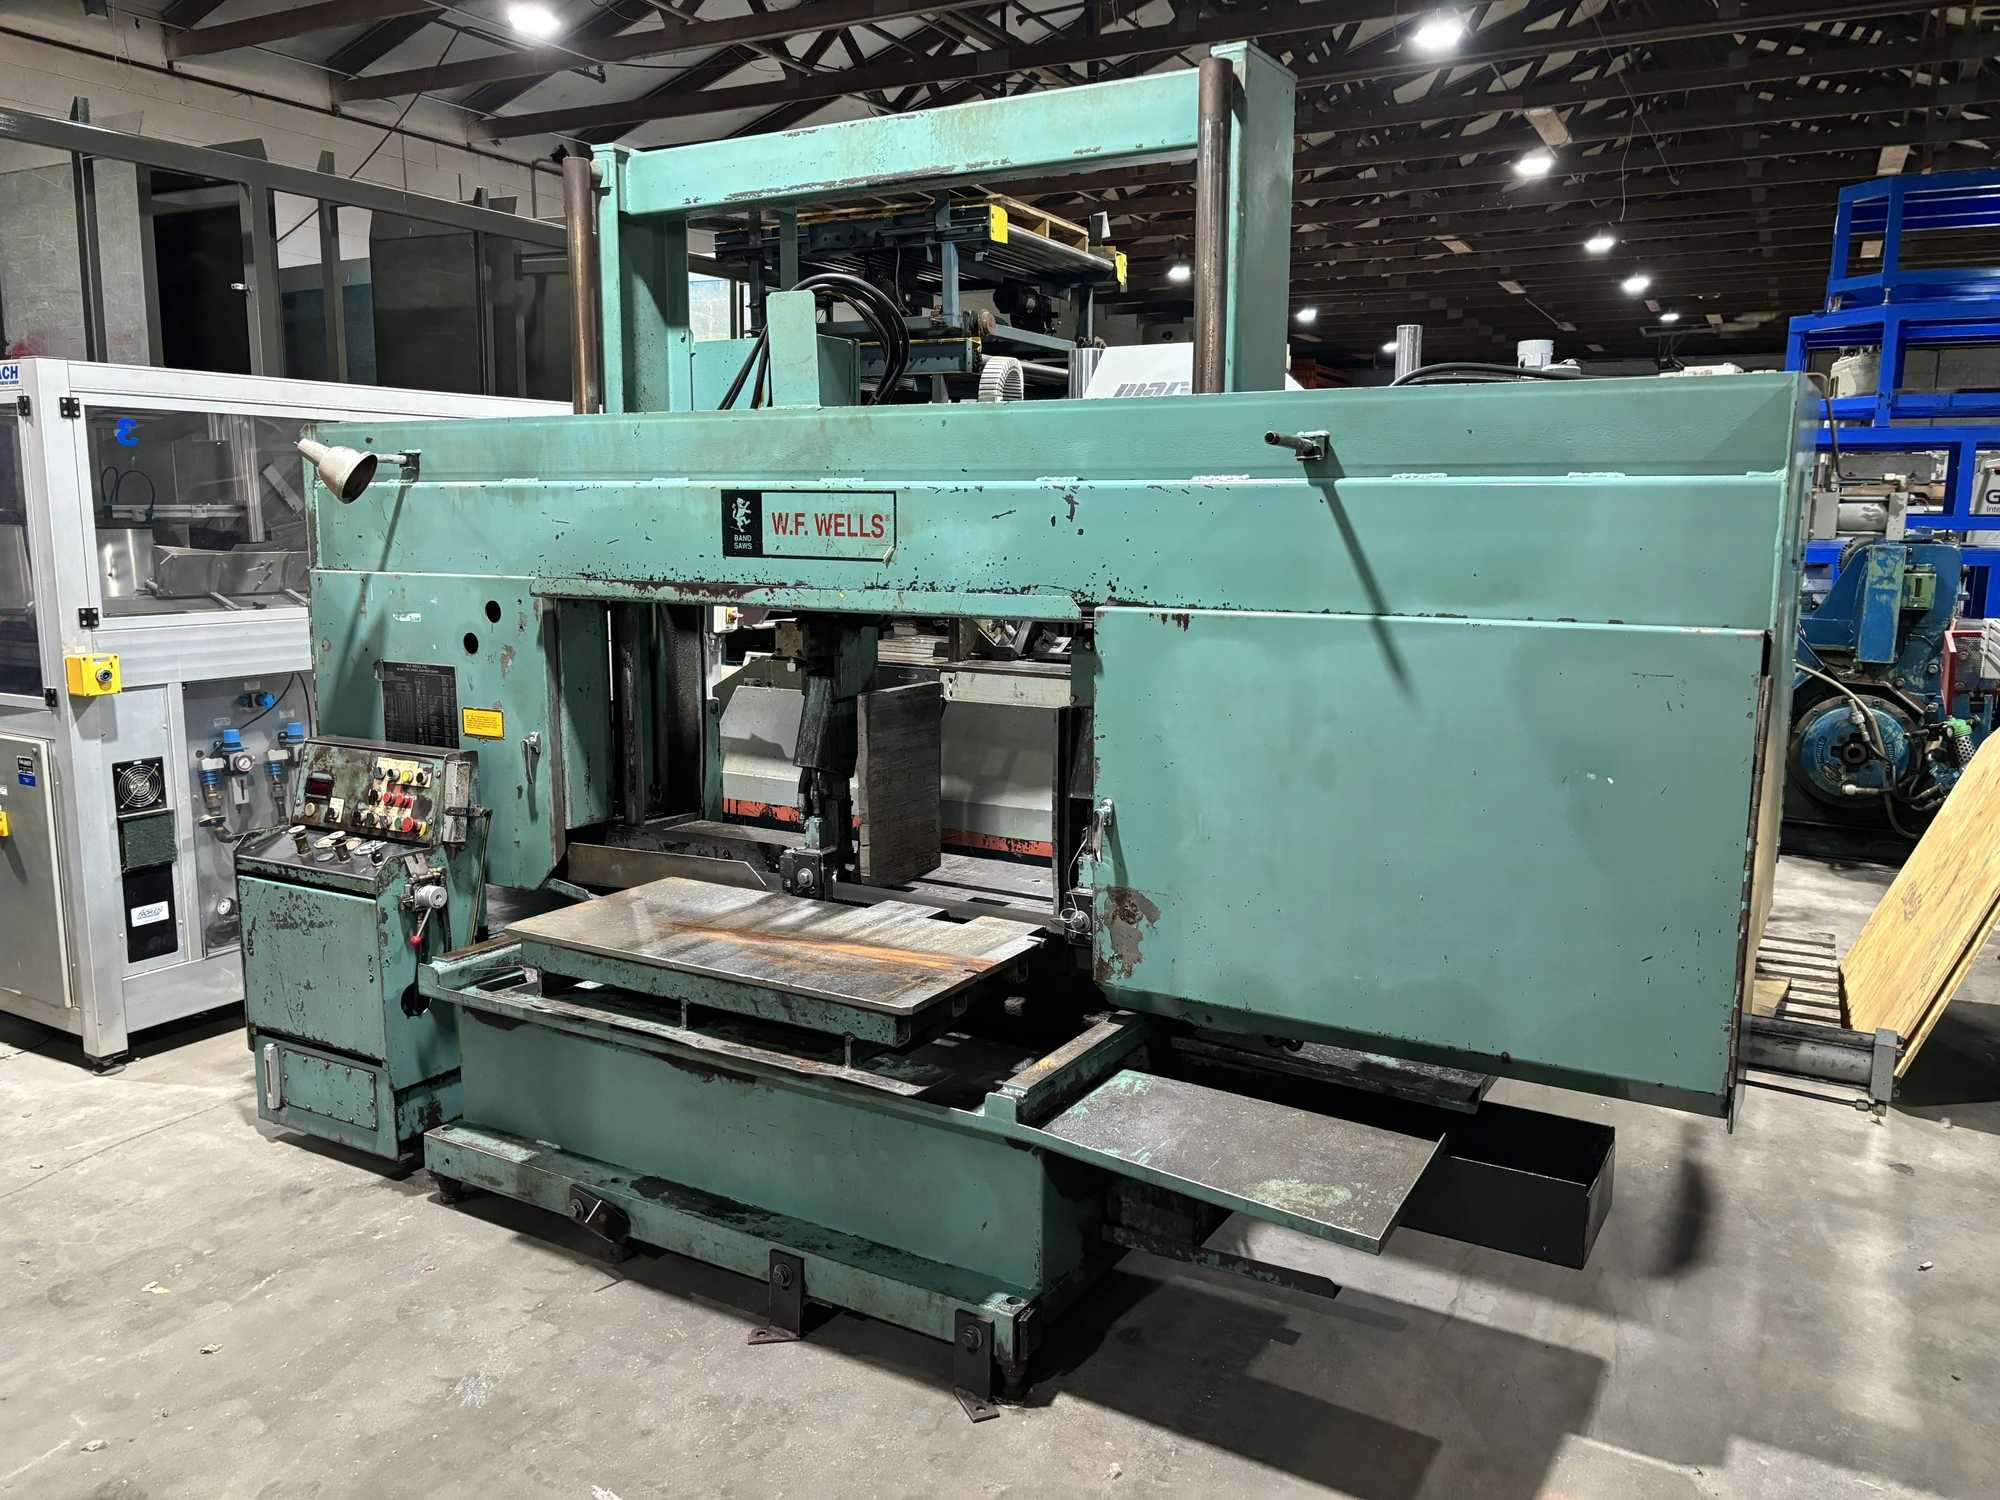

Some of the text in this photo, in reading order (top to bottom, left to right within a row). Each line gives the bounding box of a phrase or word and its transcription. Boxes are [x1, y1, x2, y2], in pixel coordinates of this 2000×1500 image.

[0, 365, 18, 380] CH
[772, 512, 884, 538] W.F. WELLS
[734, 534, 752, 542] BAND
[734, 542, 753, 550] SAWS
